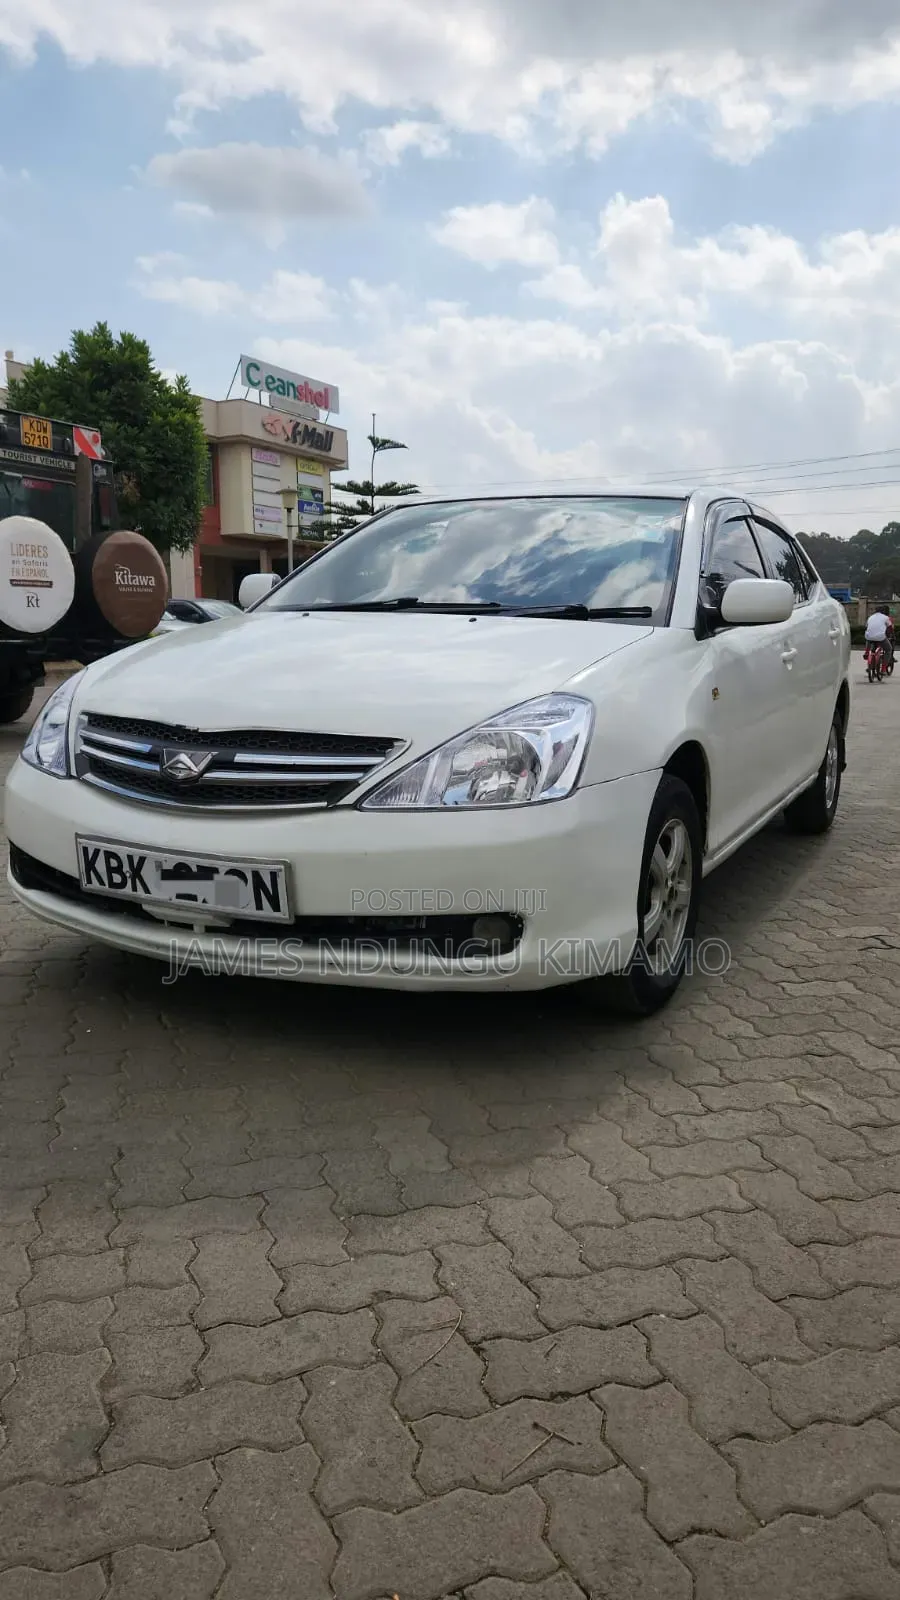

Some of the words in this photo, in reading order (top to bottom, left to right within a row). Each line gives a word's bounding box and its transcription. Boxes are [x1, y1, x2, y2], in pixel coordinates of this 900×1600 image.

[29, 419, 48, 435] KDW
[2, 449, 37, 463] TOURIST
[39, 455, 74, 469] VEHICLE
[114, 567, 155, 587] Kitawa
[26, 593, 40, 608] Kt
[82, 846, 152, 894] KBK
